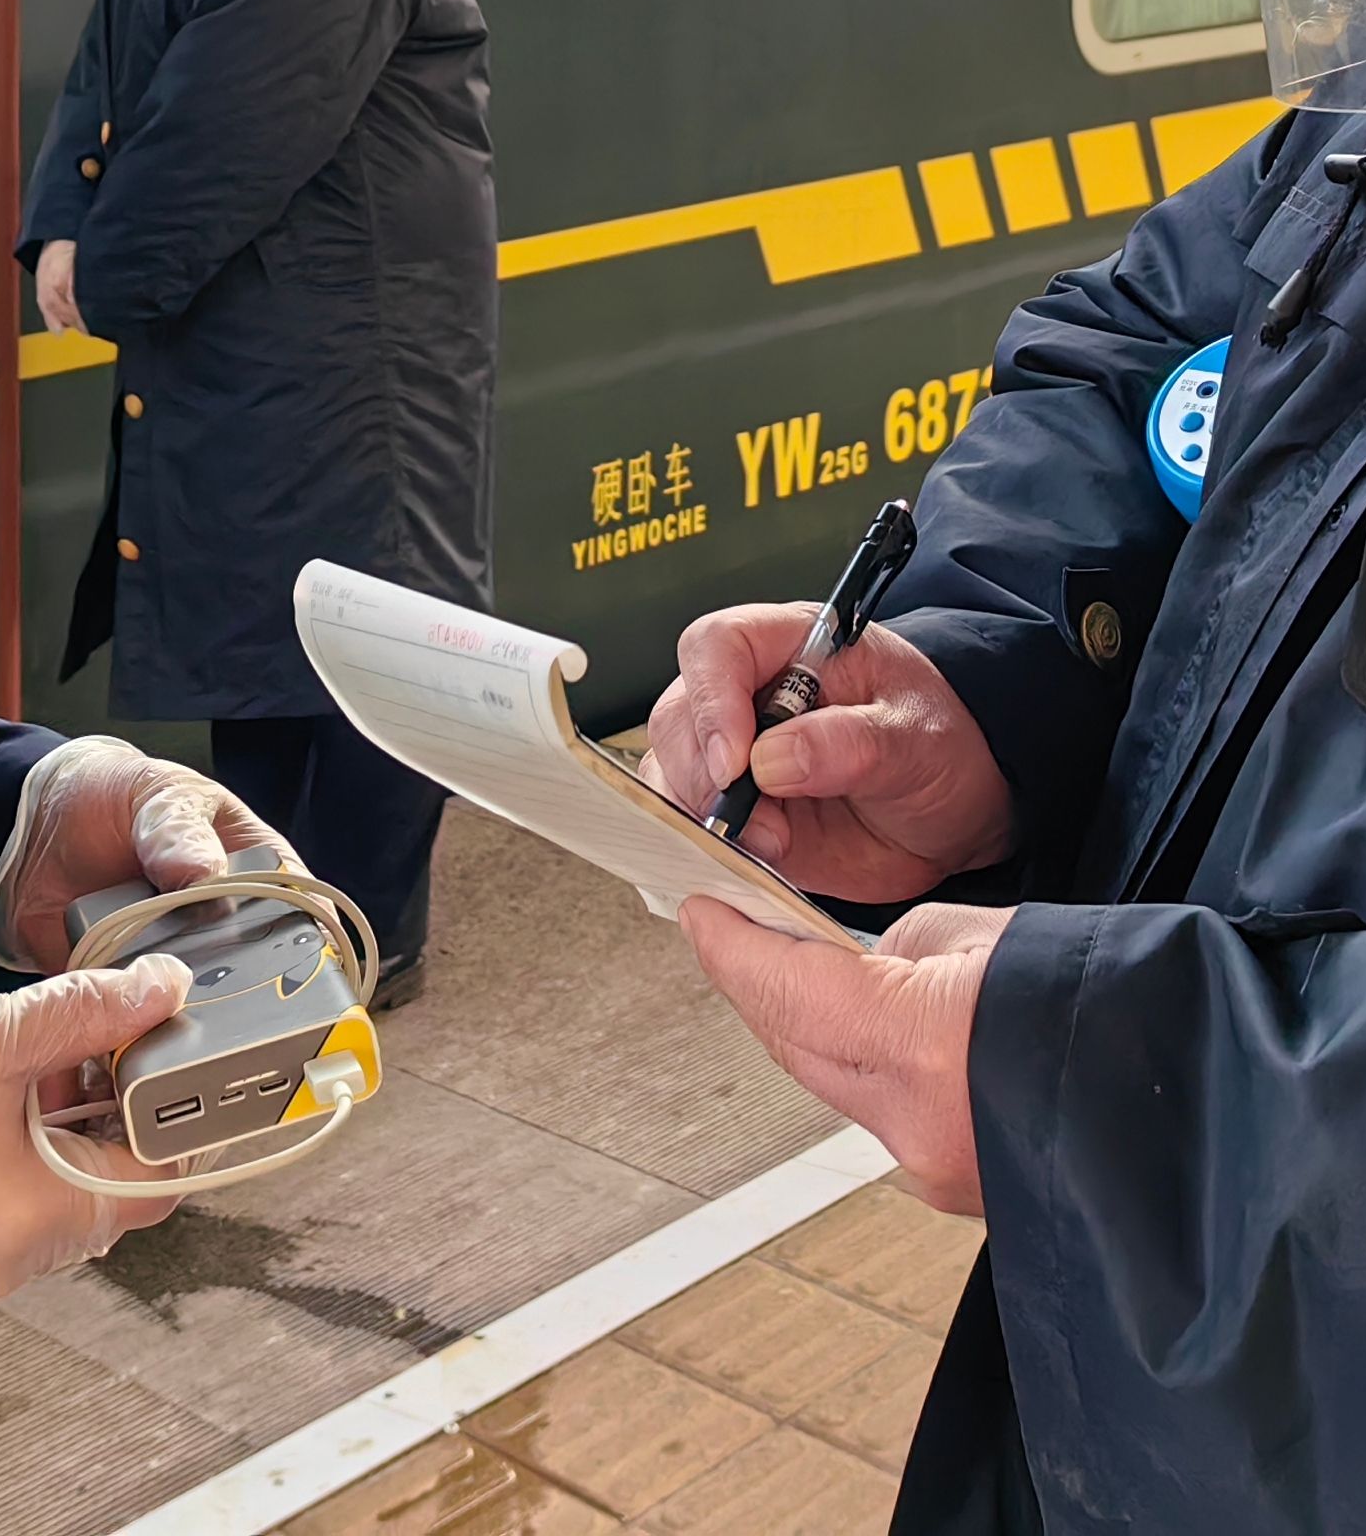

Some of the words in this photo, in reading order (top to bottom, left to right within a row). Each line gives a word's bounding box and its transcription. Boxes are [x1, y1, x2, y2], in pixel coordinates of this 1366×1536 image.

[884, 364, 994, 464] 687
[591, 442, 694, 527] 硬卧车
[572, 505, 708, 571] YINGWOCHE
